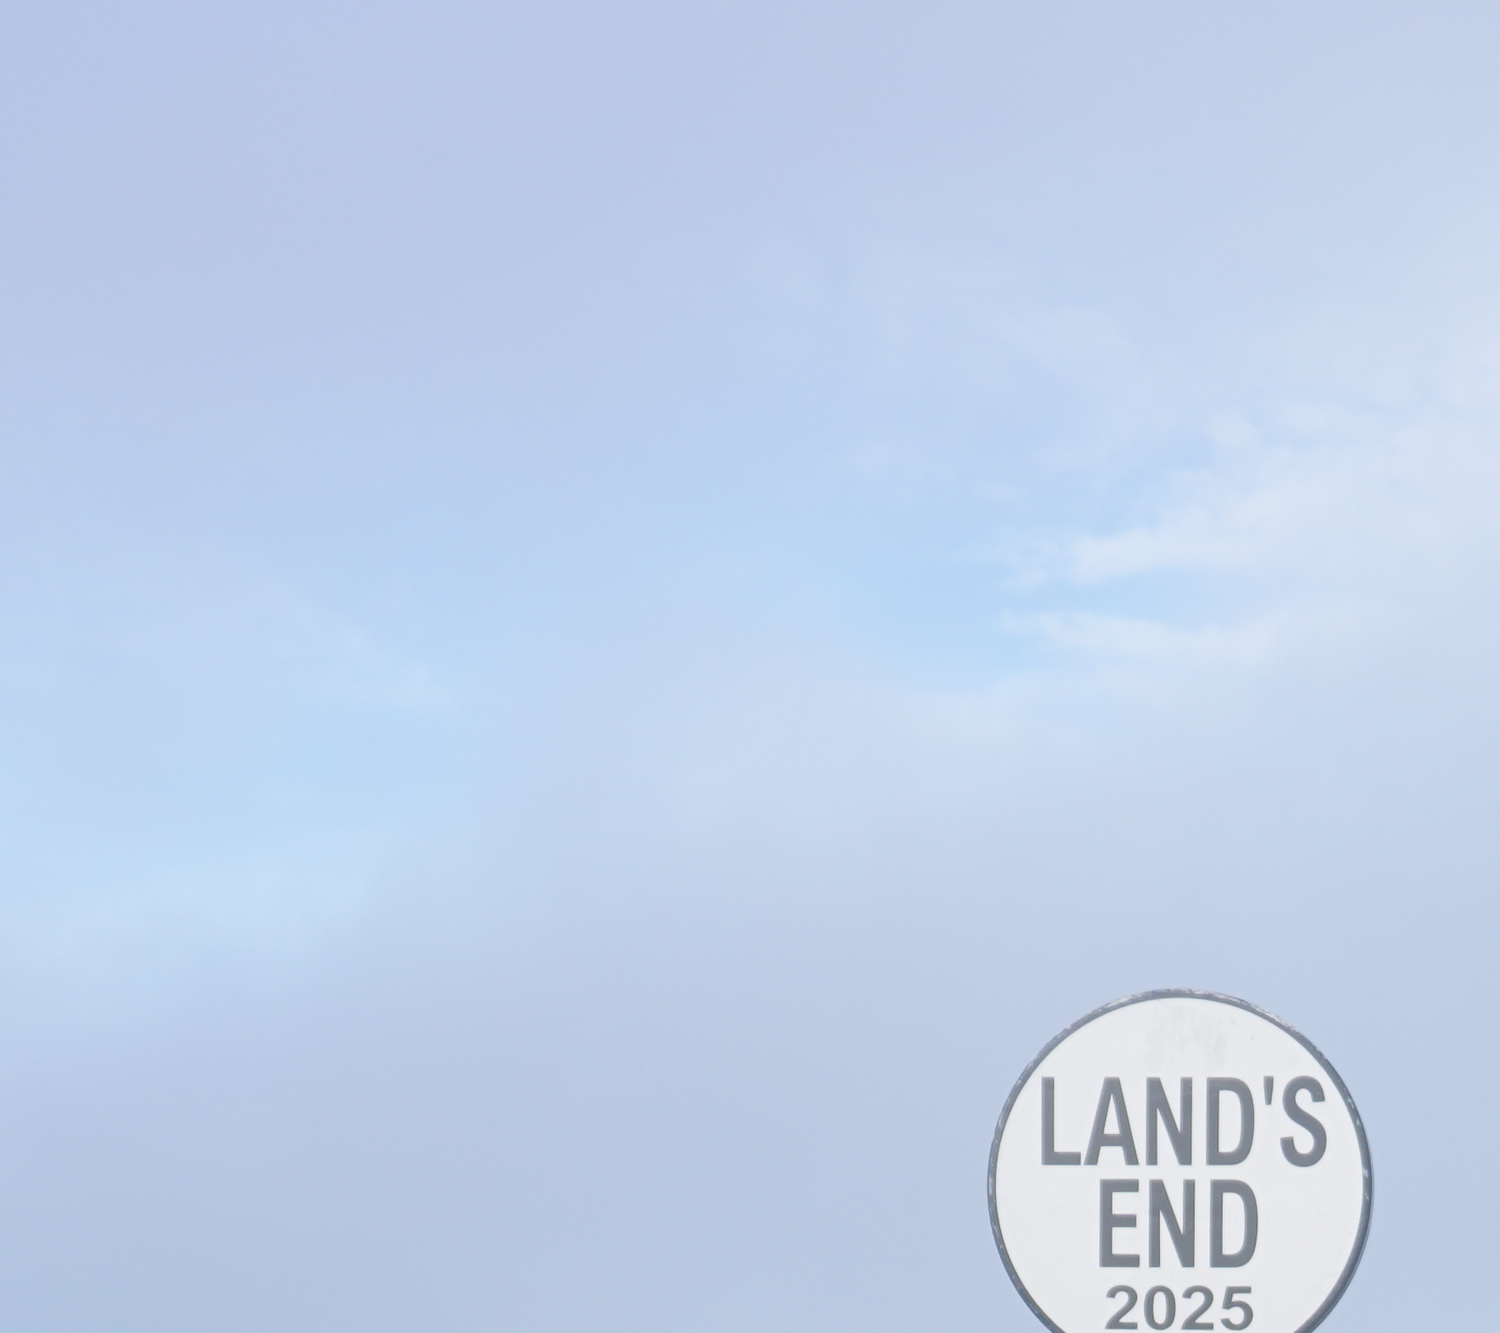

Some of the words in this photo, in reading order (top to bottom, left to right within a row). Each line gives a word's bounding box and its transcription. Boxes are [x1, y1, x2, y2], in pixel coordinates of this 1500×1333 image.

[1041, 1075, 1327, 1168] LAND'S
[1099, 1179, 1259, 1268] END
[1105, 1285, 1254, 1331] 2025
